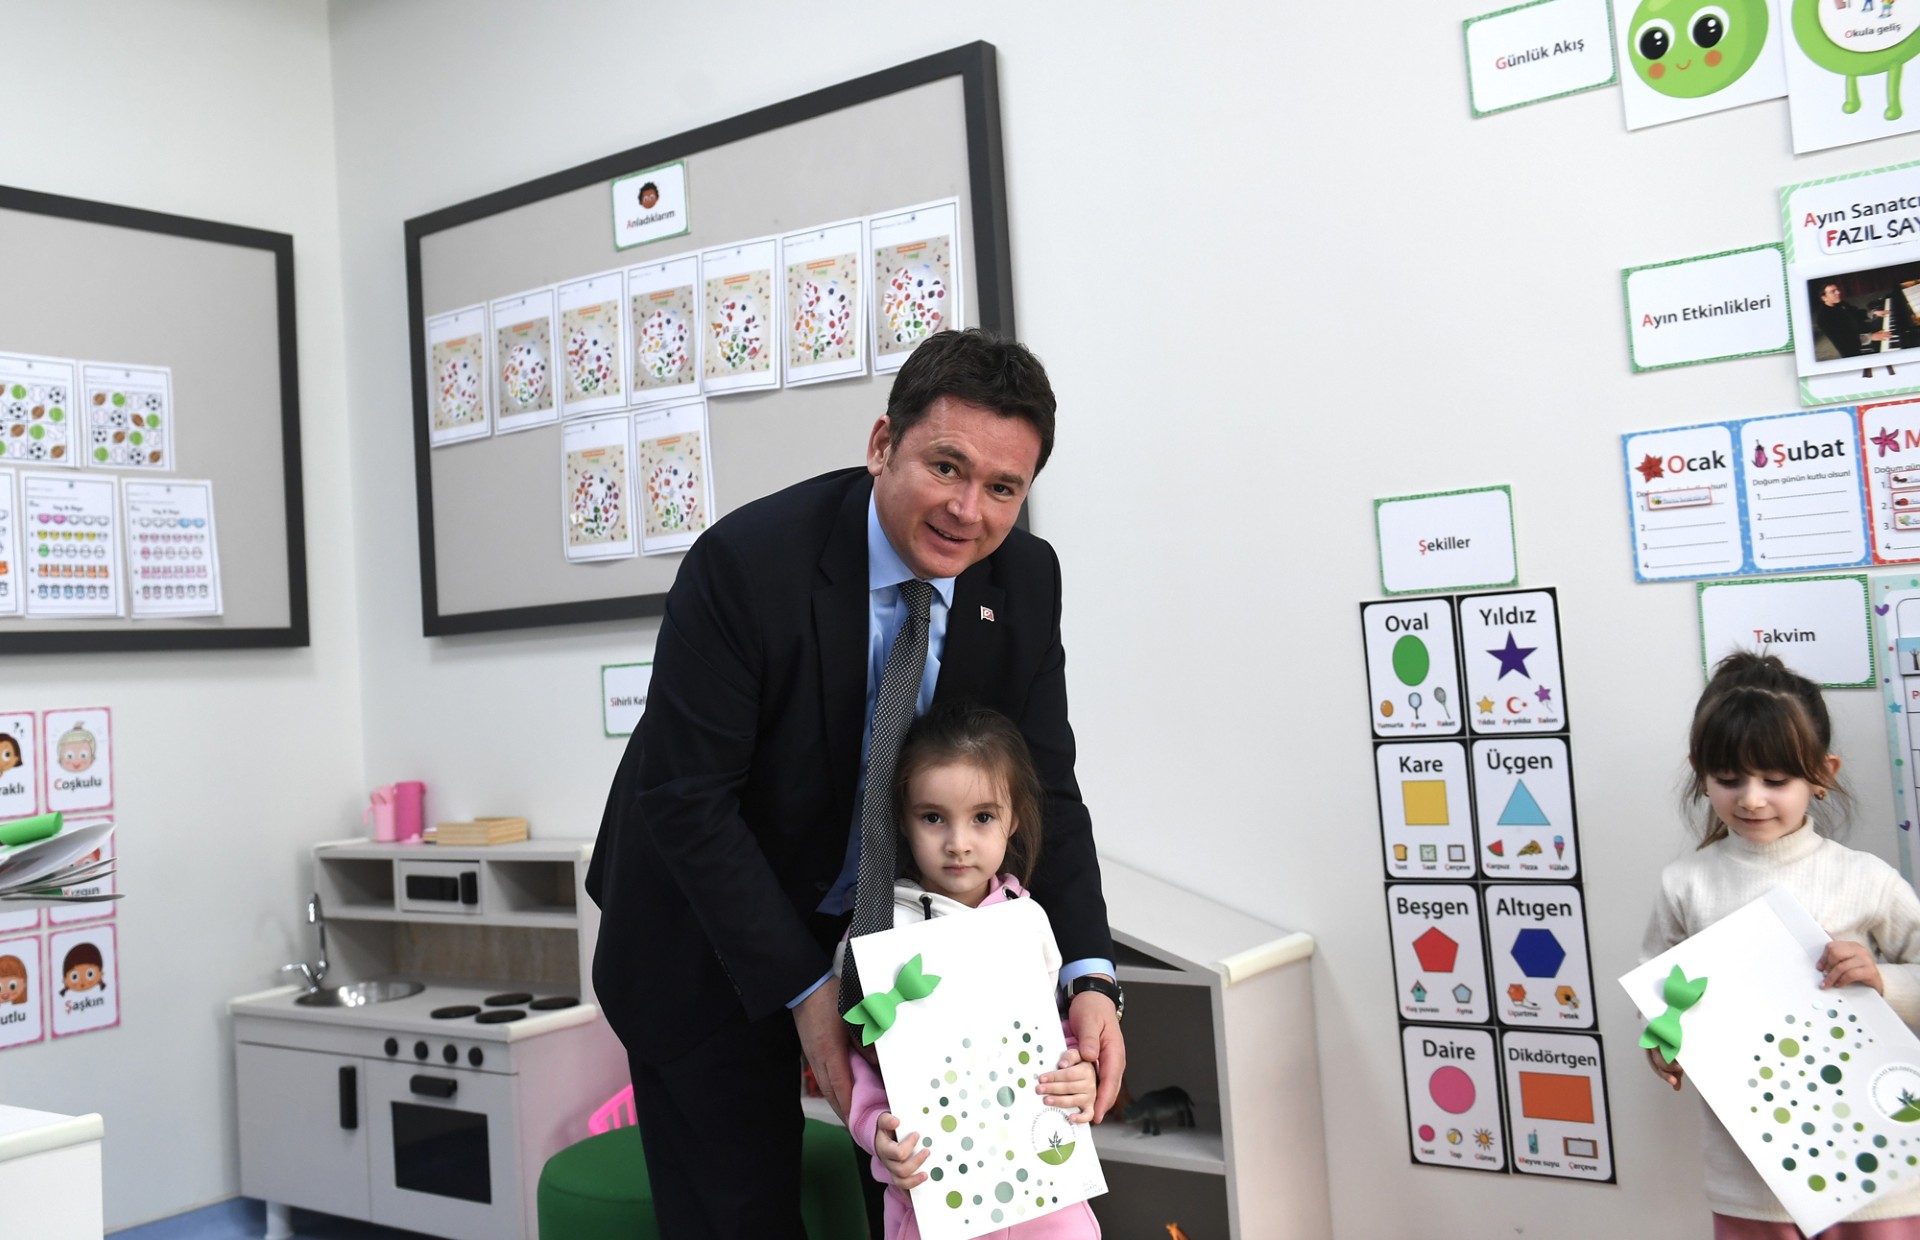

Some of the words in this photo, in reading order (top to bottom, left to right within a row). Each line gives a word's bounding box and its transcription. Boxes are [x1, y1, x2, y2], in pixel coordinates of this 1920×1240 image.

[1844, 27, 1874, 39] Okula
[1876, 22, 1902, 36] geliş
[1495, 46, 1550, 70] Günlük
[1552, 38, 1585, 53] Akış
[626, 210, 676, 230] Anladıklarım
[1803, 210, 1846, 229] Ayın
[1825, 224, 1883, 248] FAZIL
[1641, 312, 1678, 329] Ayın
[1682, 294, 1771, 321] Etkinlikleri
[1667, 450, 1727, 474] Ocak
[1772, 438, 1846, 469] Şubat
[1752, 478, 1780, 487] Doğum
[1807, 472, 1827, 480] kutlu
[1881, 502, 1888, 510] 2
[1756, 513, 1763, 521] 2
[1883, 522, 1890, 530] 3
[1640, 524, 1646, 532] 2
[1759, 533, 1765, 541] 3
[1418, 536, 1471, 556] Şekiller
[1642, 543, 1648, 551] 3
[1384, 612, 1430, 633] Oval
[1479, 605, 1537, 627] Yıldız
[1753, 628, 1816, 644] Takvim
[610, 695, 632, 707] Sihirli
[1376, 722, 1405, 730] Yumurta
[1398, 755, 1444, 774] Kare
[1486, 749, 1554, 775] Üçgen
[0, 781, 25, 796] aklı
[54, 776, 103, 792] Coşkulu
[1396, 897, 1469, 920] Beşgen
[1496, 897, 1573, 922] Altıgen
[65, 995, 104, 1015] Şaşkın
[1507, 1009, 1539, 1019] Uçurtma
[1421, 1039, 1477, 1061] Daire
[1508, 1047, 1598, 1069] Dikdörtgen
